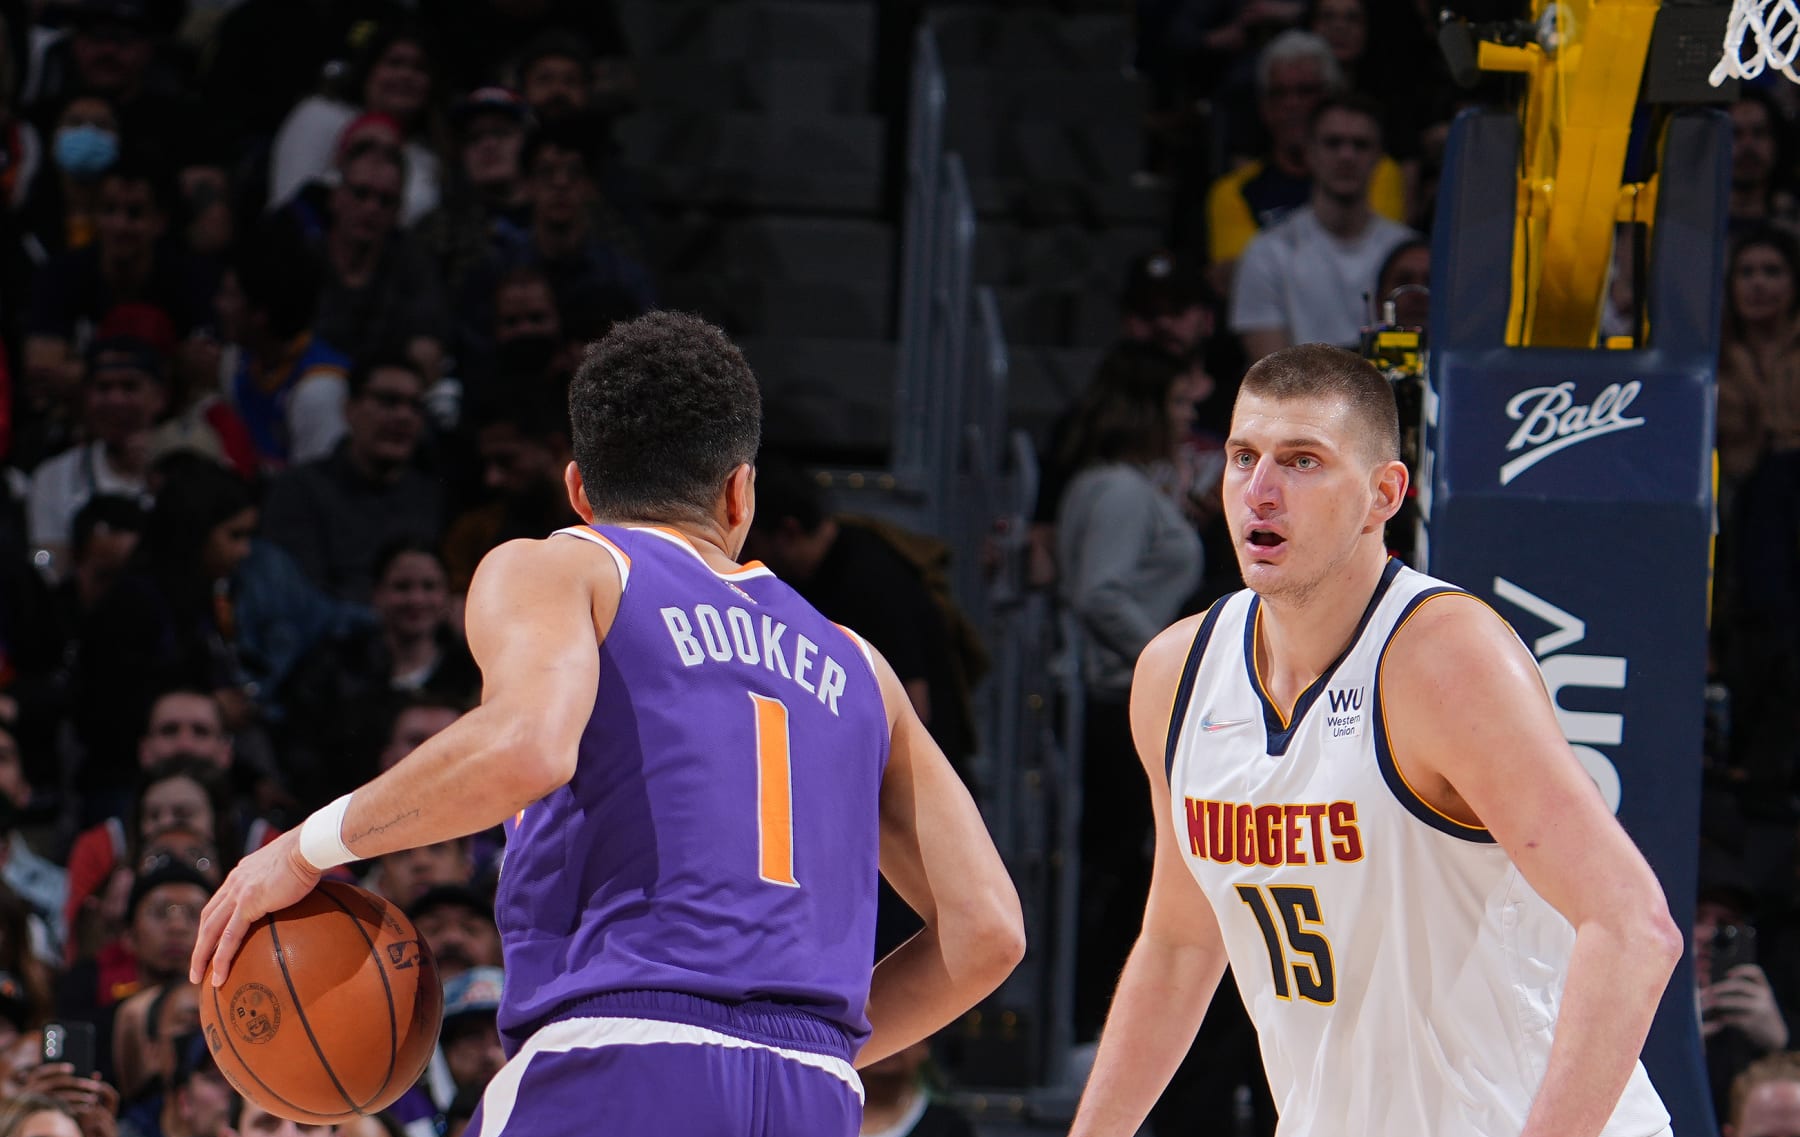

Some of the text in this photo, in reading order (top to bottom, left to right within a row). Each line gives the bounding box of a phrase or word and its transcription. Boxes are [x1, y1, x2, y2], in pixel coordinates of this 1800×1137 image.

[1505, 380, 1645, 452] Ball
[660, 604, 847, 717] BOOKER
[1327, 714, 1361, 727] Western
[1328, 686, 1364, 713] WU
[1333, 725, 1355, 738] Union
[748, 691, 800, 888] 1
[1184, 796, 1366, 868] NUGGETS
[1232, 882, 1337, 1007] 15
